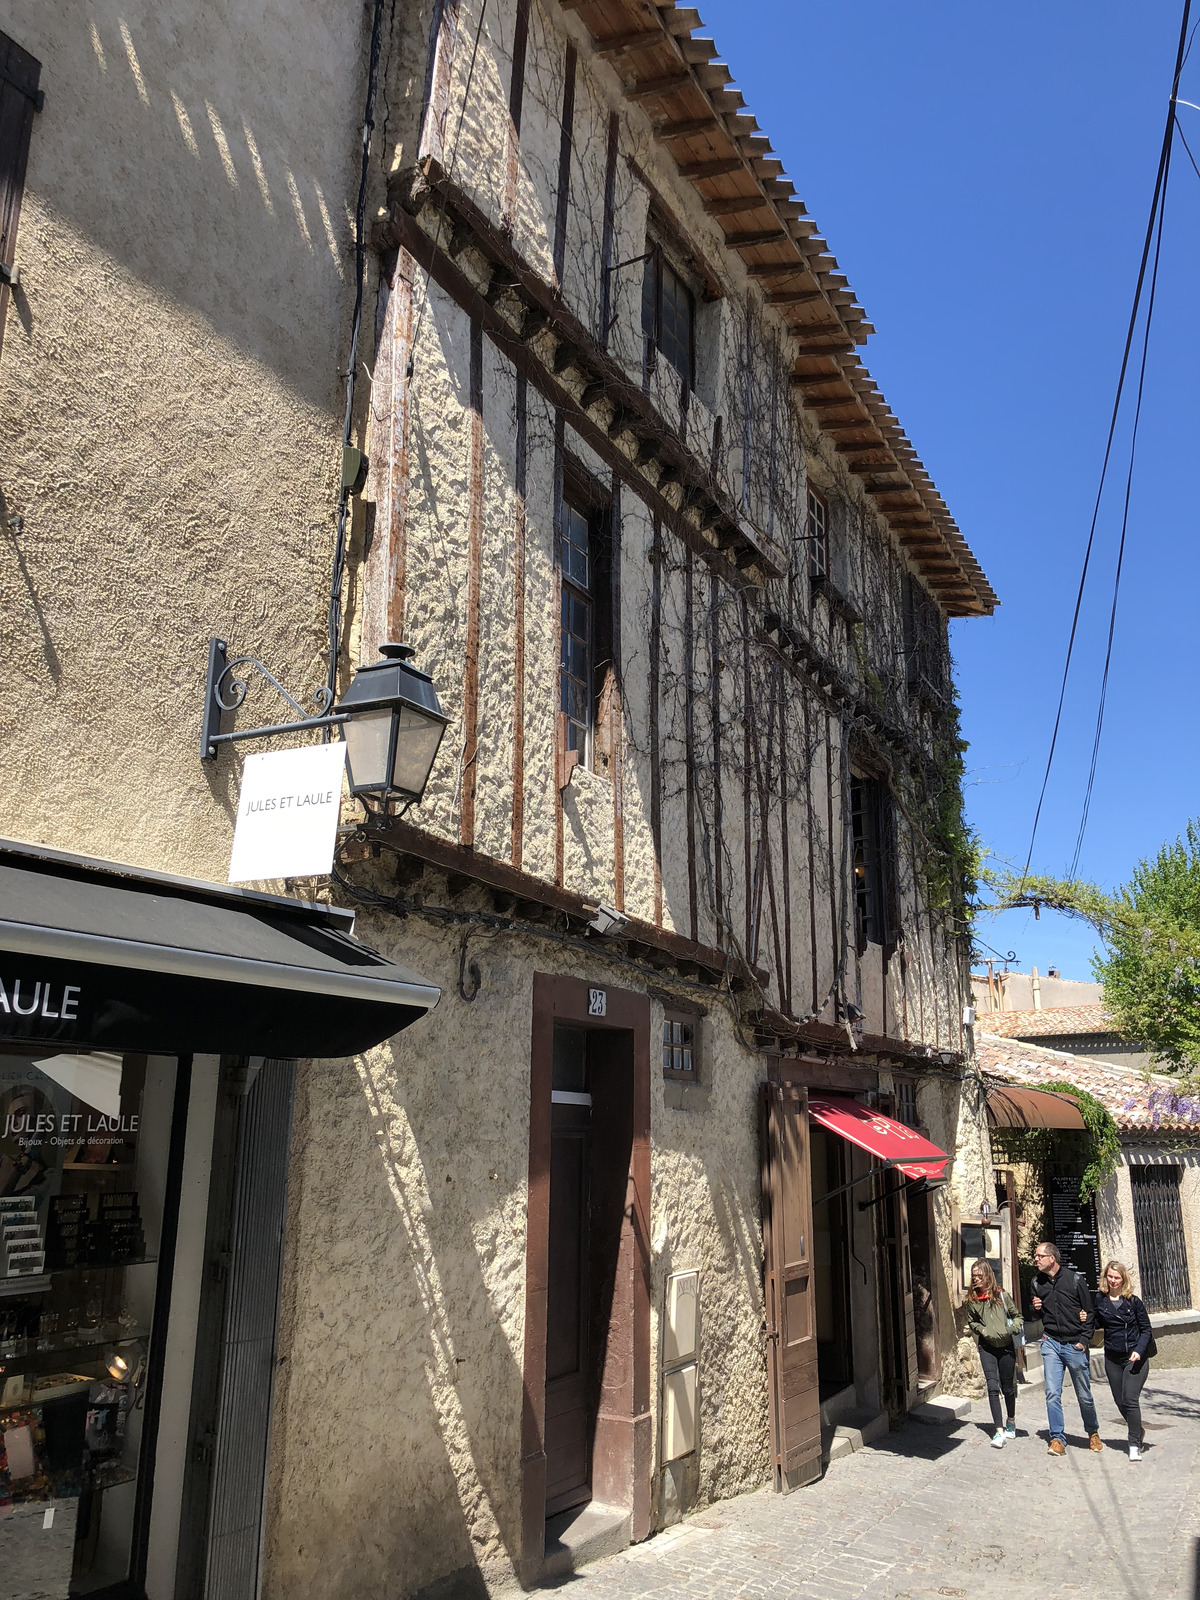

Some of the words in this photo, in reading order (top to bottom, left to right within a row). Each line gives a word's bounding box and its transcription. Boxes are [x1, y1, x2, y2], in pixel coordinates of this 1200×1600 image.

[245, 798, 277, 816] JULES
[279, 796, 294, 809] ET
[296, 791, 333, 807] LAULE
[591, 990, 604, 1015] 23
[1, 1114, 56, 1139] JULES
[60, 1114, 83, 1132] ET
[87, 1114, 139, 1132] LAULE
[18, 1137, 43, 1148] Bijoux
[50, 1136, 75, 1148] Objets
[76, 1136, 86, 1146] de
[87, 1136, 124, 1146] décoration
